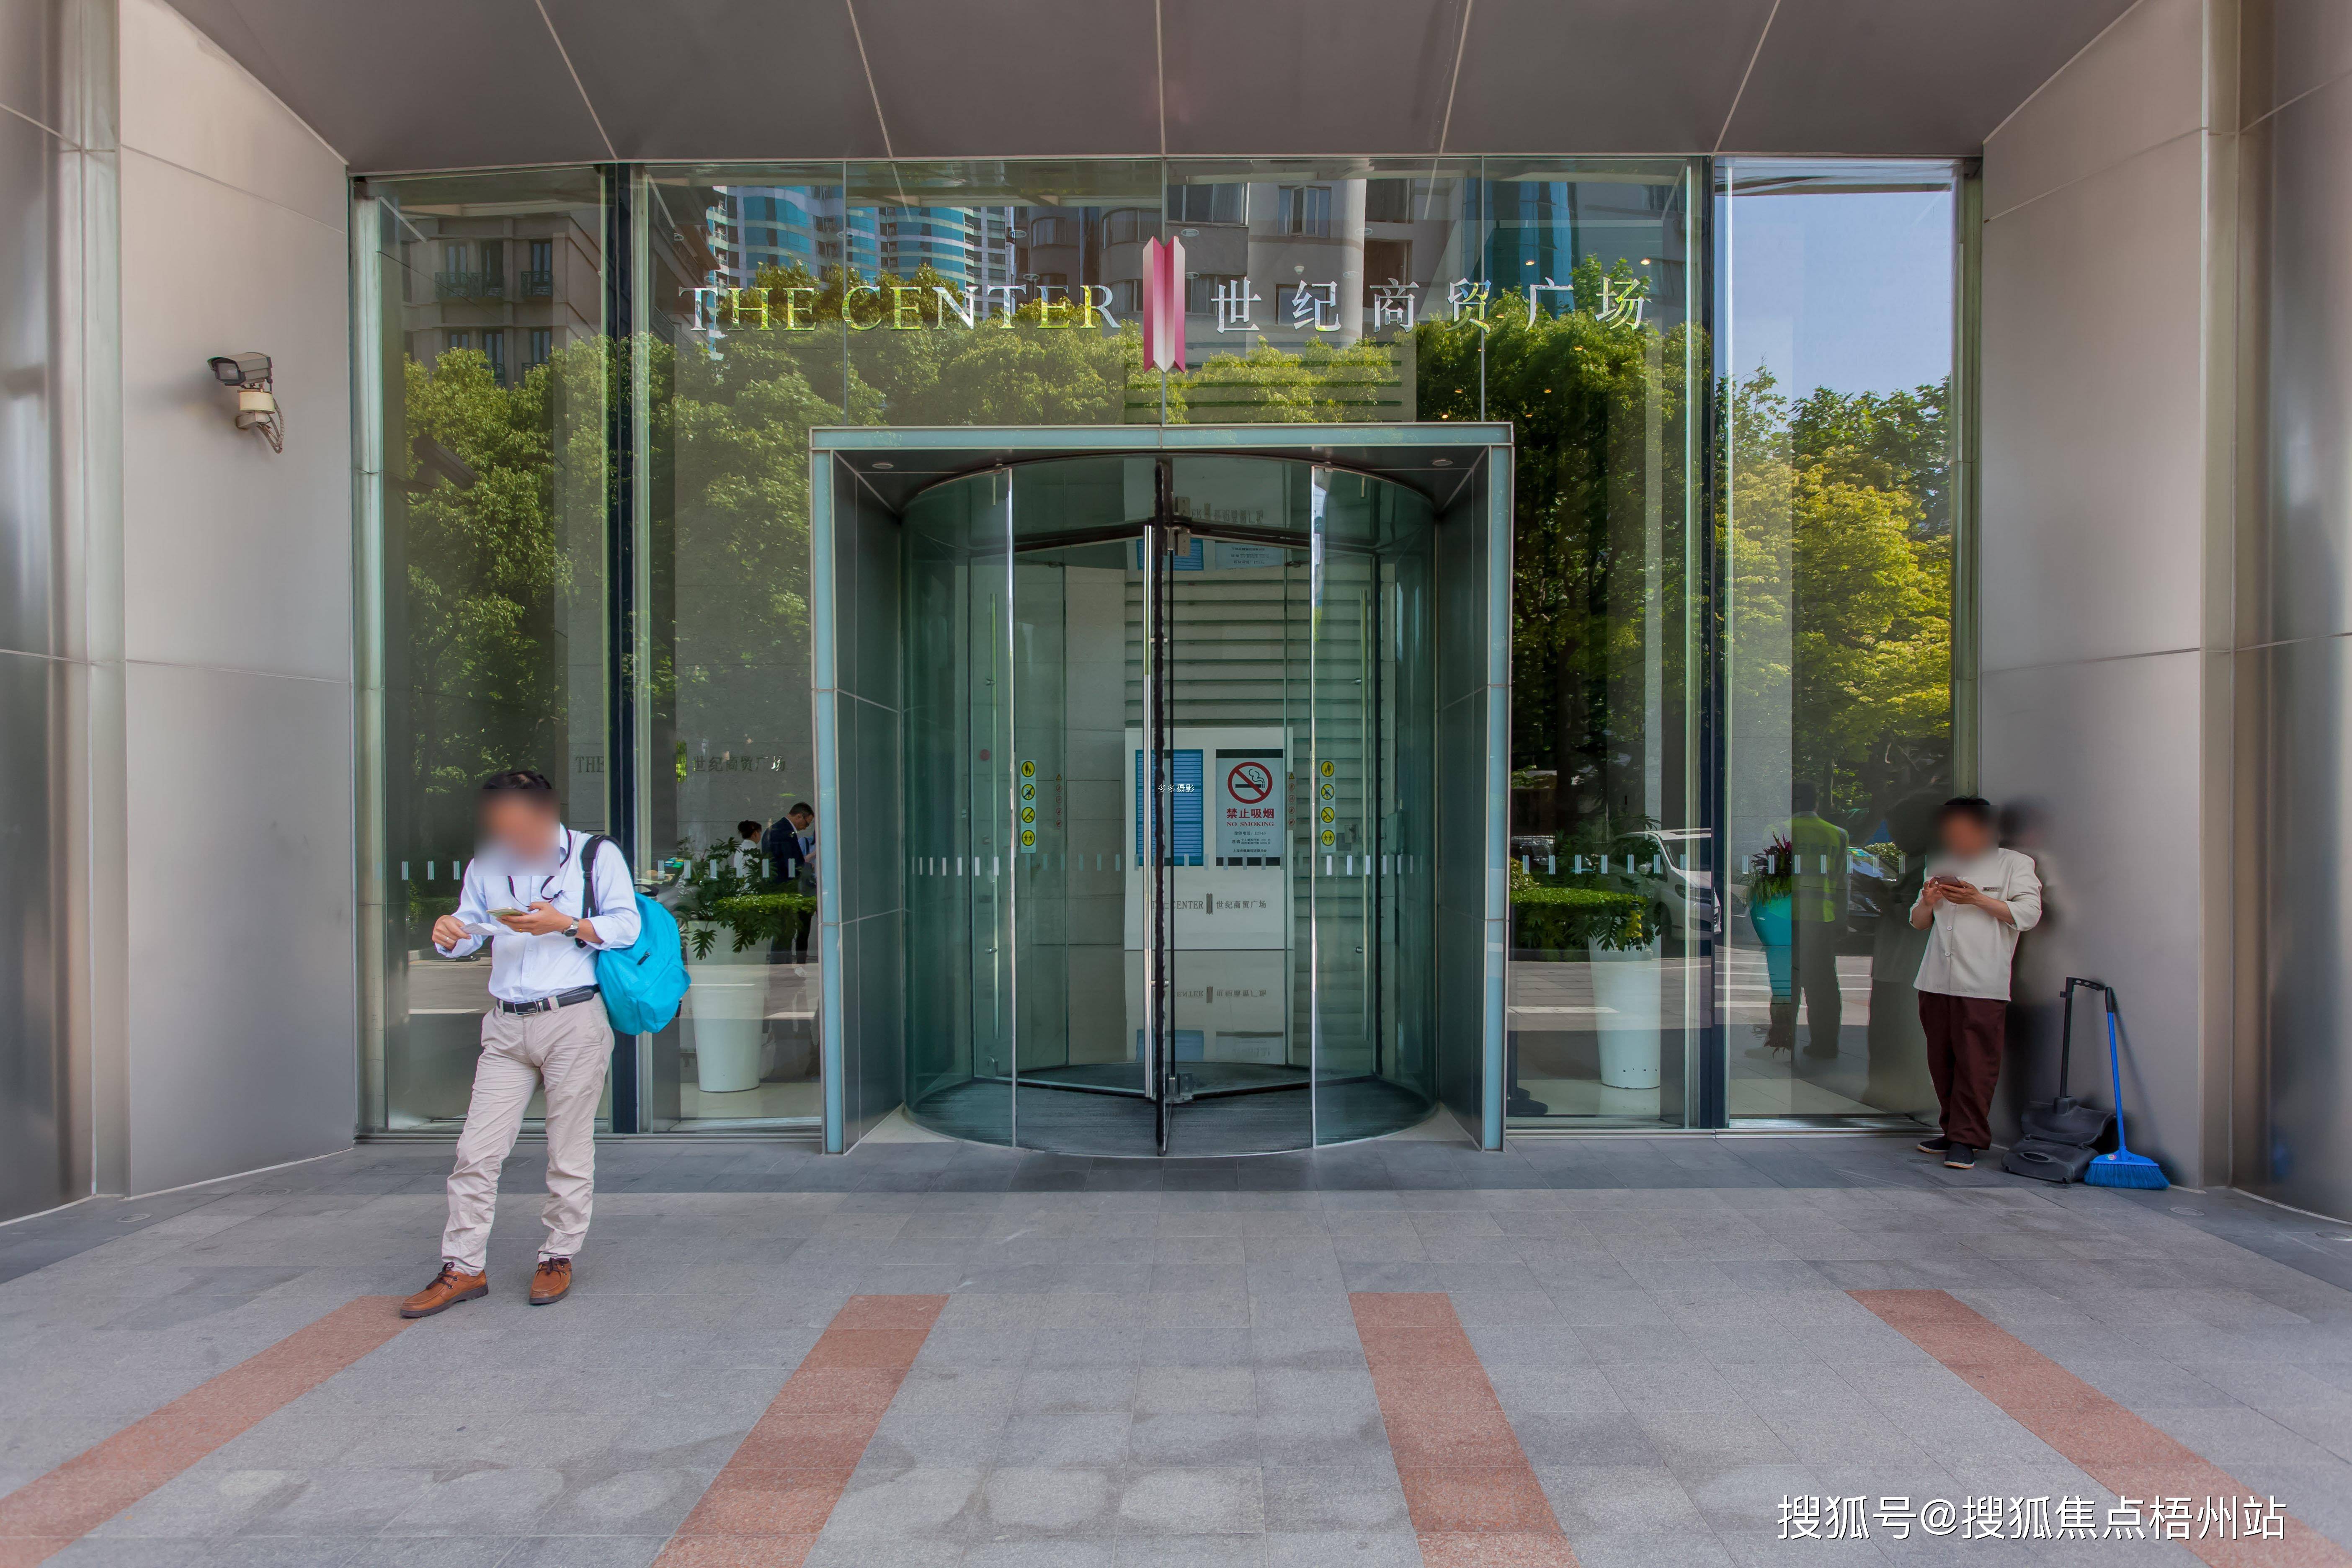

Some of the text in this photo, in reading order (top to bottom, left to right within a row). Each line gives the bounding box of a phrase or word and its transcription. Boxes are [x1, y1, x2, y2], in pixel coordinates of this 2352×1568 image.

[678, 286, 1122, 332] THE CENTER
[1211, 276, 1652, 334] 世纪商贸广场
[692, 755, 786, 773] 世纪商贸广场
[1226, 808, 1274, 819] 禁止吸烟
[1216, 900, 1266, 909] 世纪商贸广场
